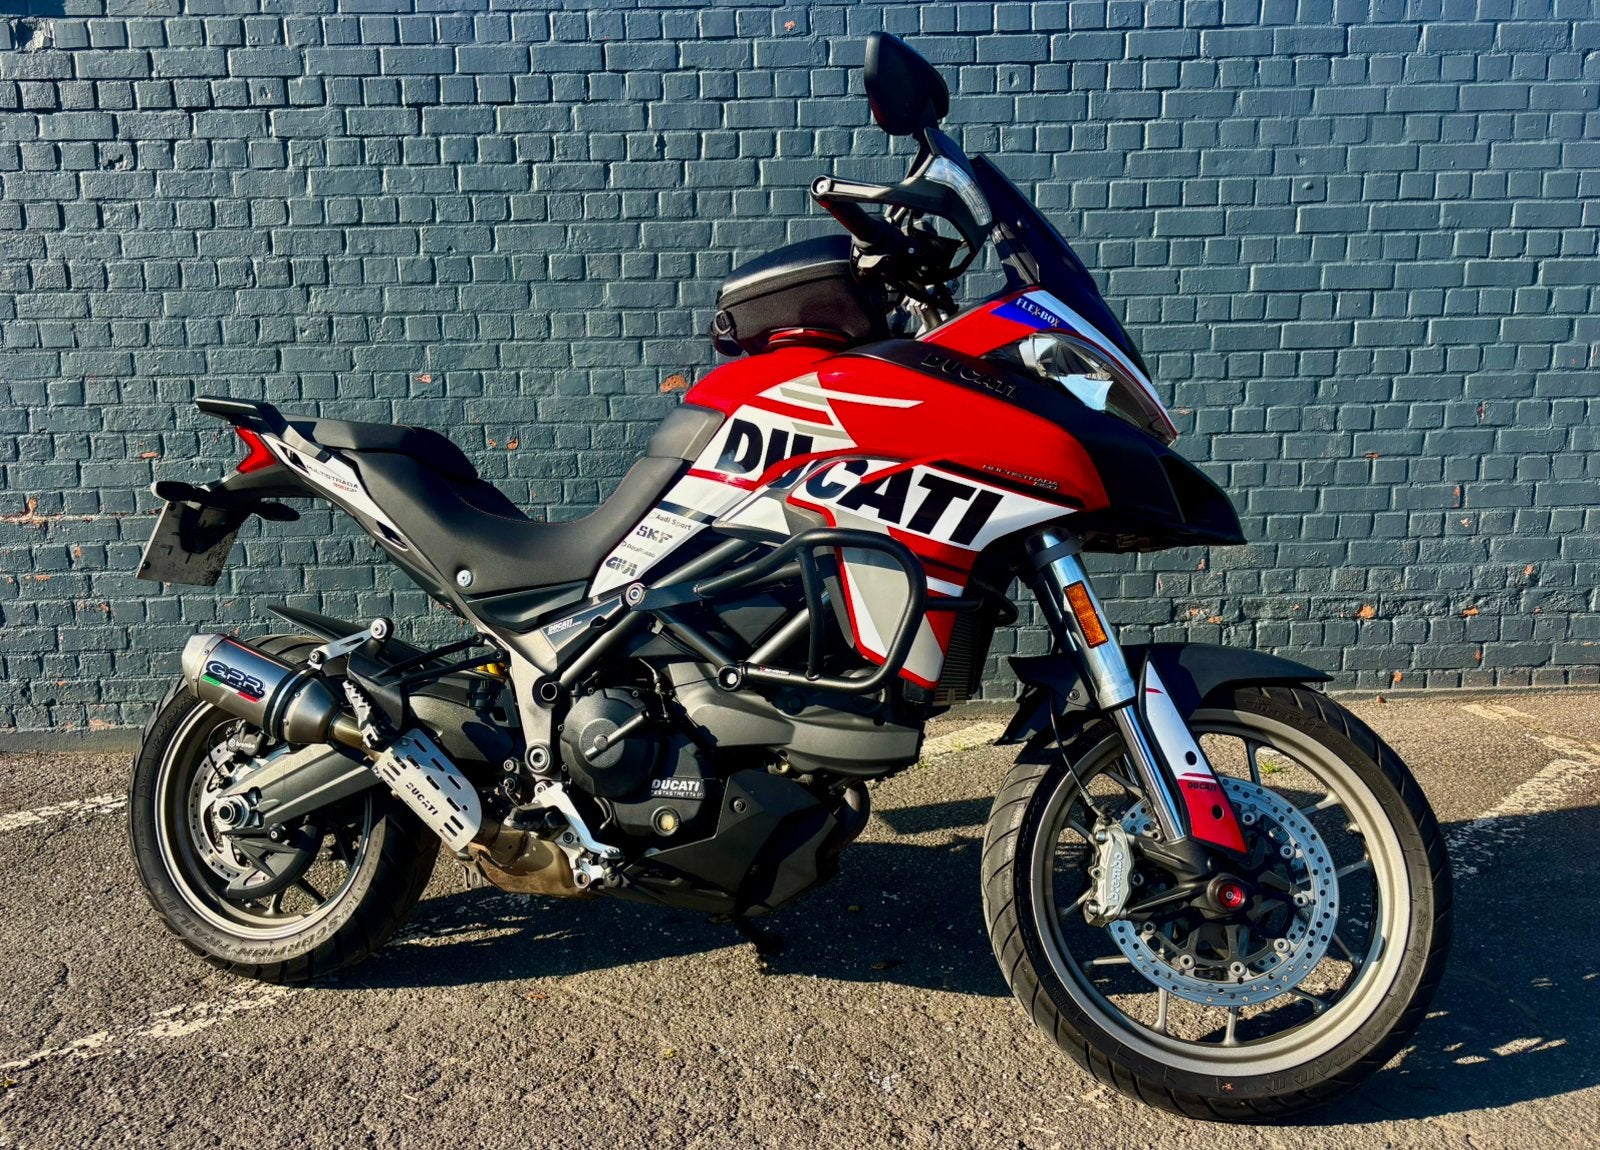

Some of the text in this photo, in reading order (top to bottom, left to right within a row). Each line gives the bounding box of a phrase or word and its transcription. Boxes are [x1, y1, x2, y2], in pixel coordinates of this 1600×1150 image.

[1015, 298, 1060, 328] FLEX-BOX
[920, 352, 1021, 399] DUCATI
[714, 417, 1004, 546] DUCATI
[636, 525, 673, 544] SKF
[656, 514, 692, 531] Audi Sport
[605, 556, 639, 577] GIVI
[651, 778, 700, 792] DUCATI
[1187, 780, 1217, 792] DUCATI
[405, 782, 439, 816] DUCATI
[1109, 852, 1124, 901] brembo
